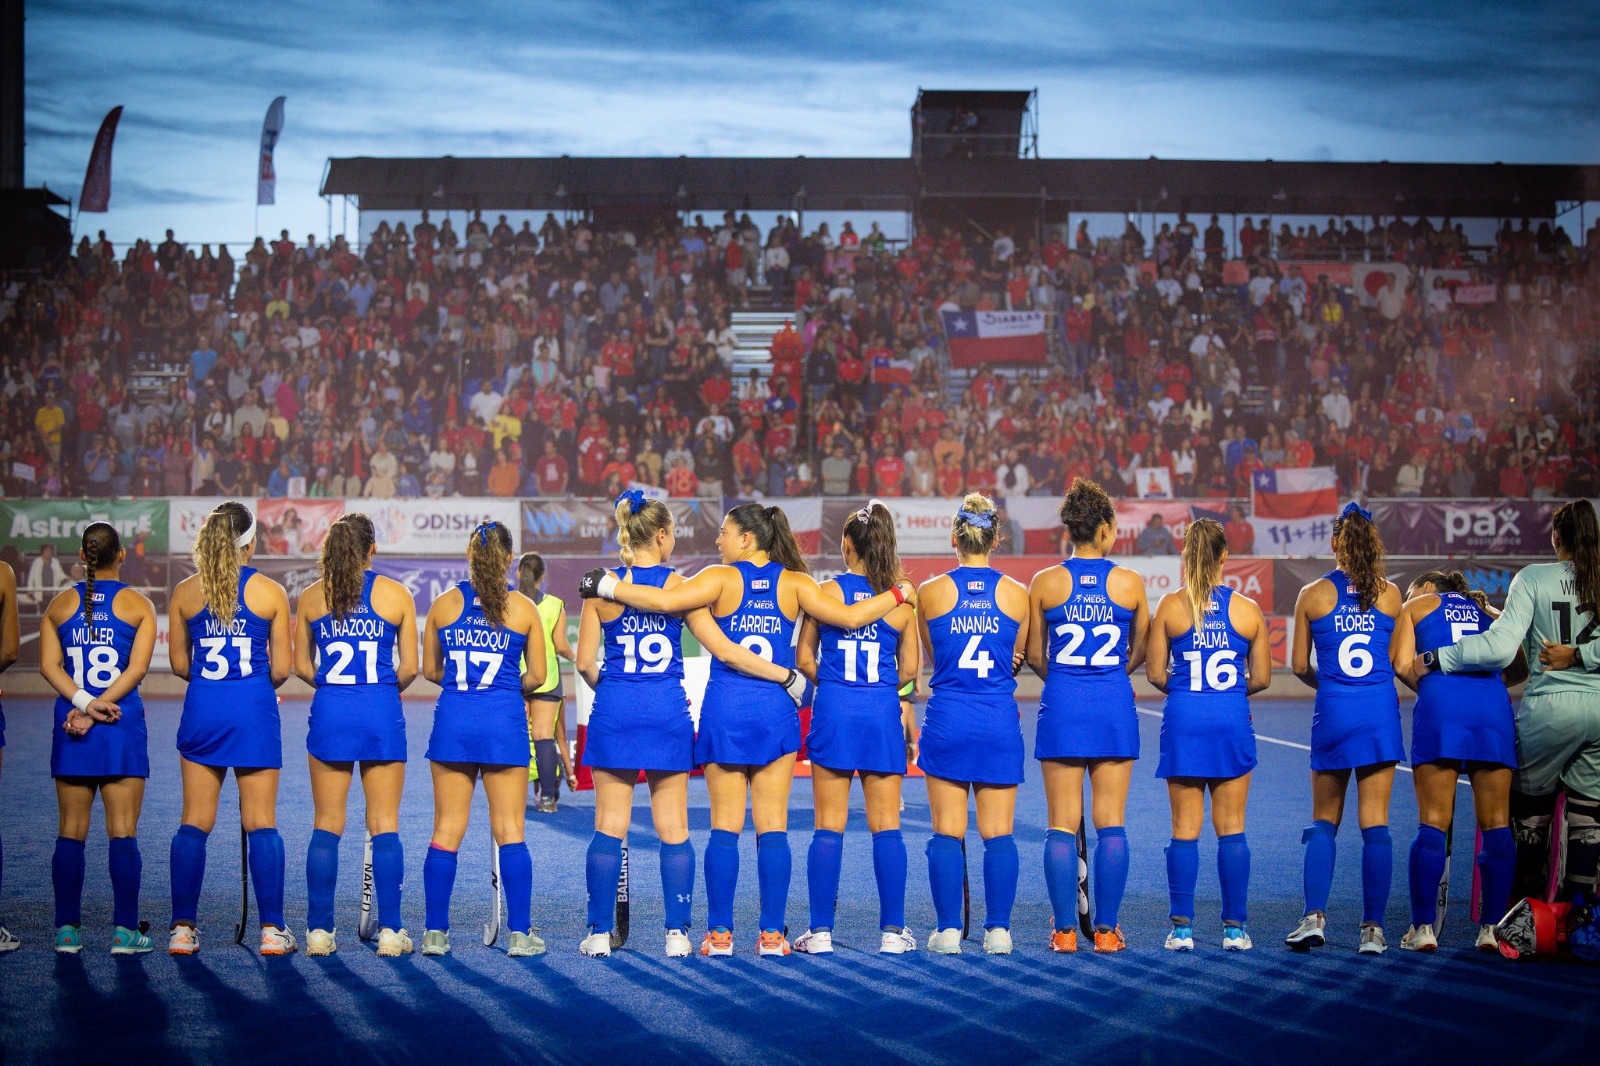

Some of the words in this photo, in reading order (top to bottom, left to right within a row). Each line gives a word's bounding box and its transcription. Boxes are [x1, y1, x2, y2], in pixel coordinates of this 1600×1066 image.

[413, 513, 490, 530] ODISH
[1445, 508, 1520, 544] pax
[1144, 575, 1169, 589] ero
[320, 622, 331, 638] A.
[331, 618, 385, 640] IRAZOQUI
[621, 615, 667, 633] SOLANO
[950, 611, 1000, 635] ANANÍAS
[1063, 604, 1114, 622] VALDIVIA
[1334, 614, 1376, 633] FLORES
[1444, 608, 1480, 623] ROJAS
[1551, 601, 1600, 645] 12
[199, 637, 253, 681] 31
[444, 629, 454, 647] F.
[454, 629, 511, 651] IRAZOQUI
[615, 633, 673, 674] 19
[958, 634, 995, 678] 4
[1055, 623, 1122, 666] 22
[1192, 631, 1230, 650] PALMA
[1338, 633, 1374, 678] 6
[66, 645, 122, 689] 18
[325, 641, 379, 685] 21
[449, 650, 504, 691] 17
[837, 639, 881, 684] 11
[1182, 649, 1238, 692] 16
